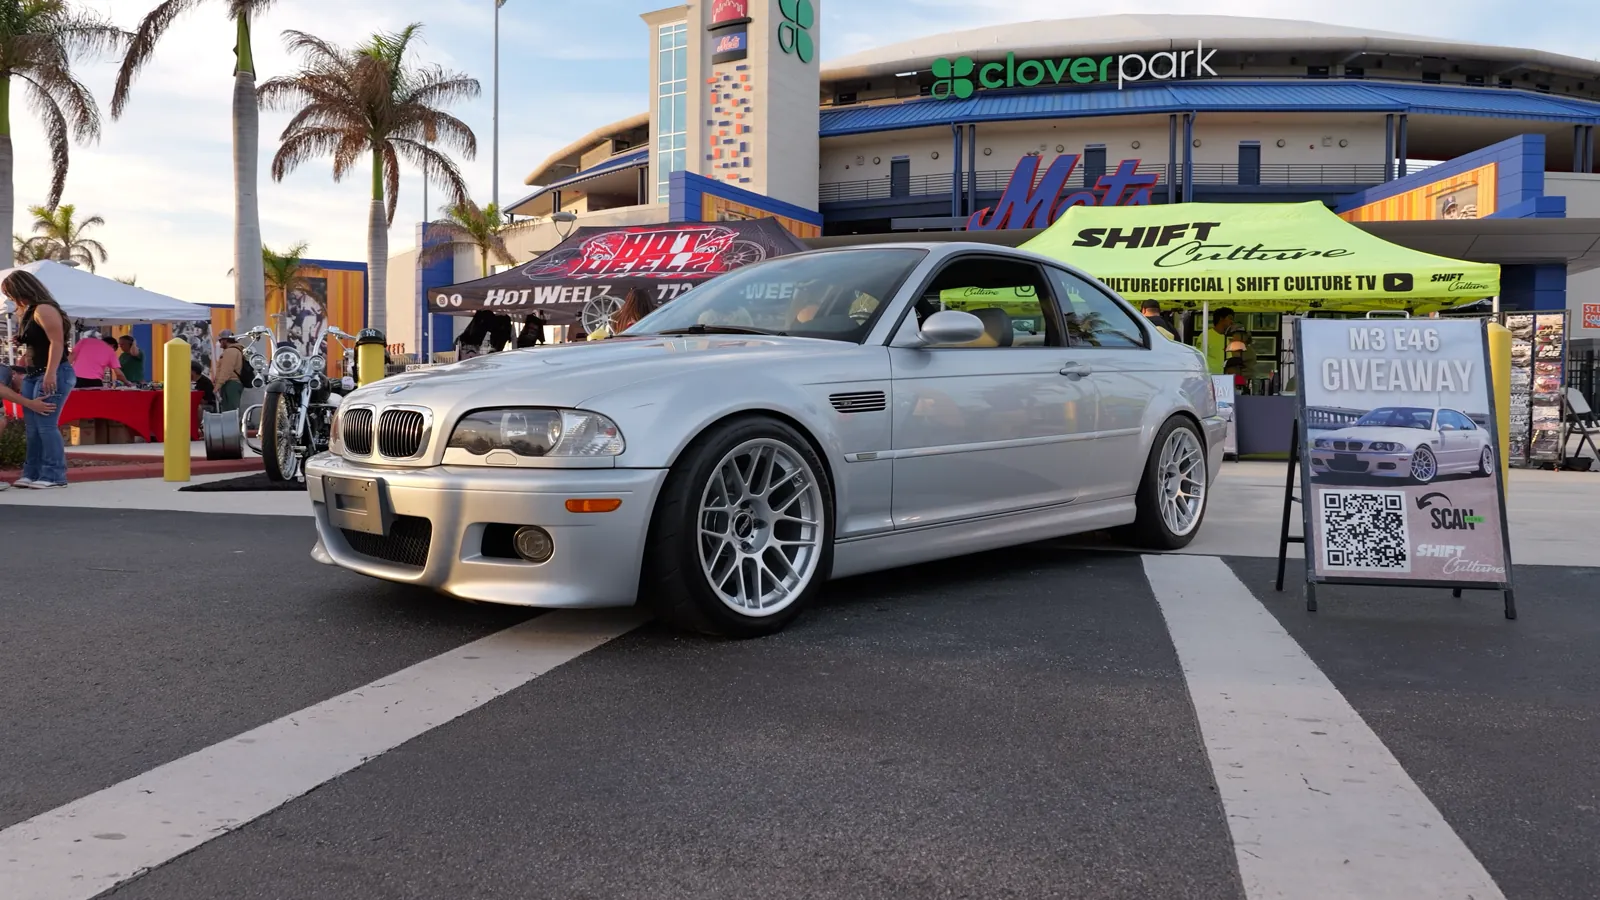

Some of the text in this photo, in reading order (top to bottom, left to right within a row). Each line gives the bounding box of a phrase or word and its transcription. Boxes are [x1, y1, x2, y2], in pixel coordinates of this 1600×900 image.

[1072, 222, 1221, 249] SHIFT
[1154, 240, 1355, 268] Culture
[1236, 276, 1280, 292] SHIFT
[1281, 275, 1352, 292] CULTURE
[1356, 274, 1376, 291] TV
[1430, 273, 1464, 282] SHIFT
[1448, 281, 1490, 292] Culture
[484, 289, 532, 306] HOT
[1350, 327, 1440, 351] M3 E46
[1322, 358, 1474, 392] GIVEAWAY
[1430, 508, 1475, 530] SCAN
[1416, 544, 1466, 557] SHIFT
[1443, 557, 1505, 574] Culture
